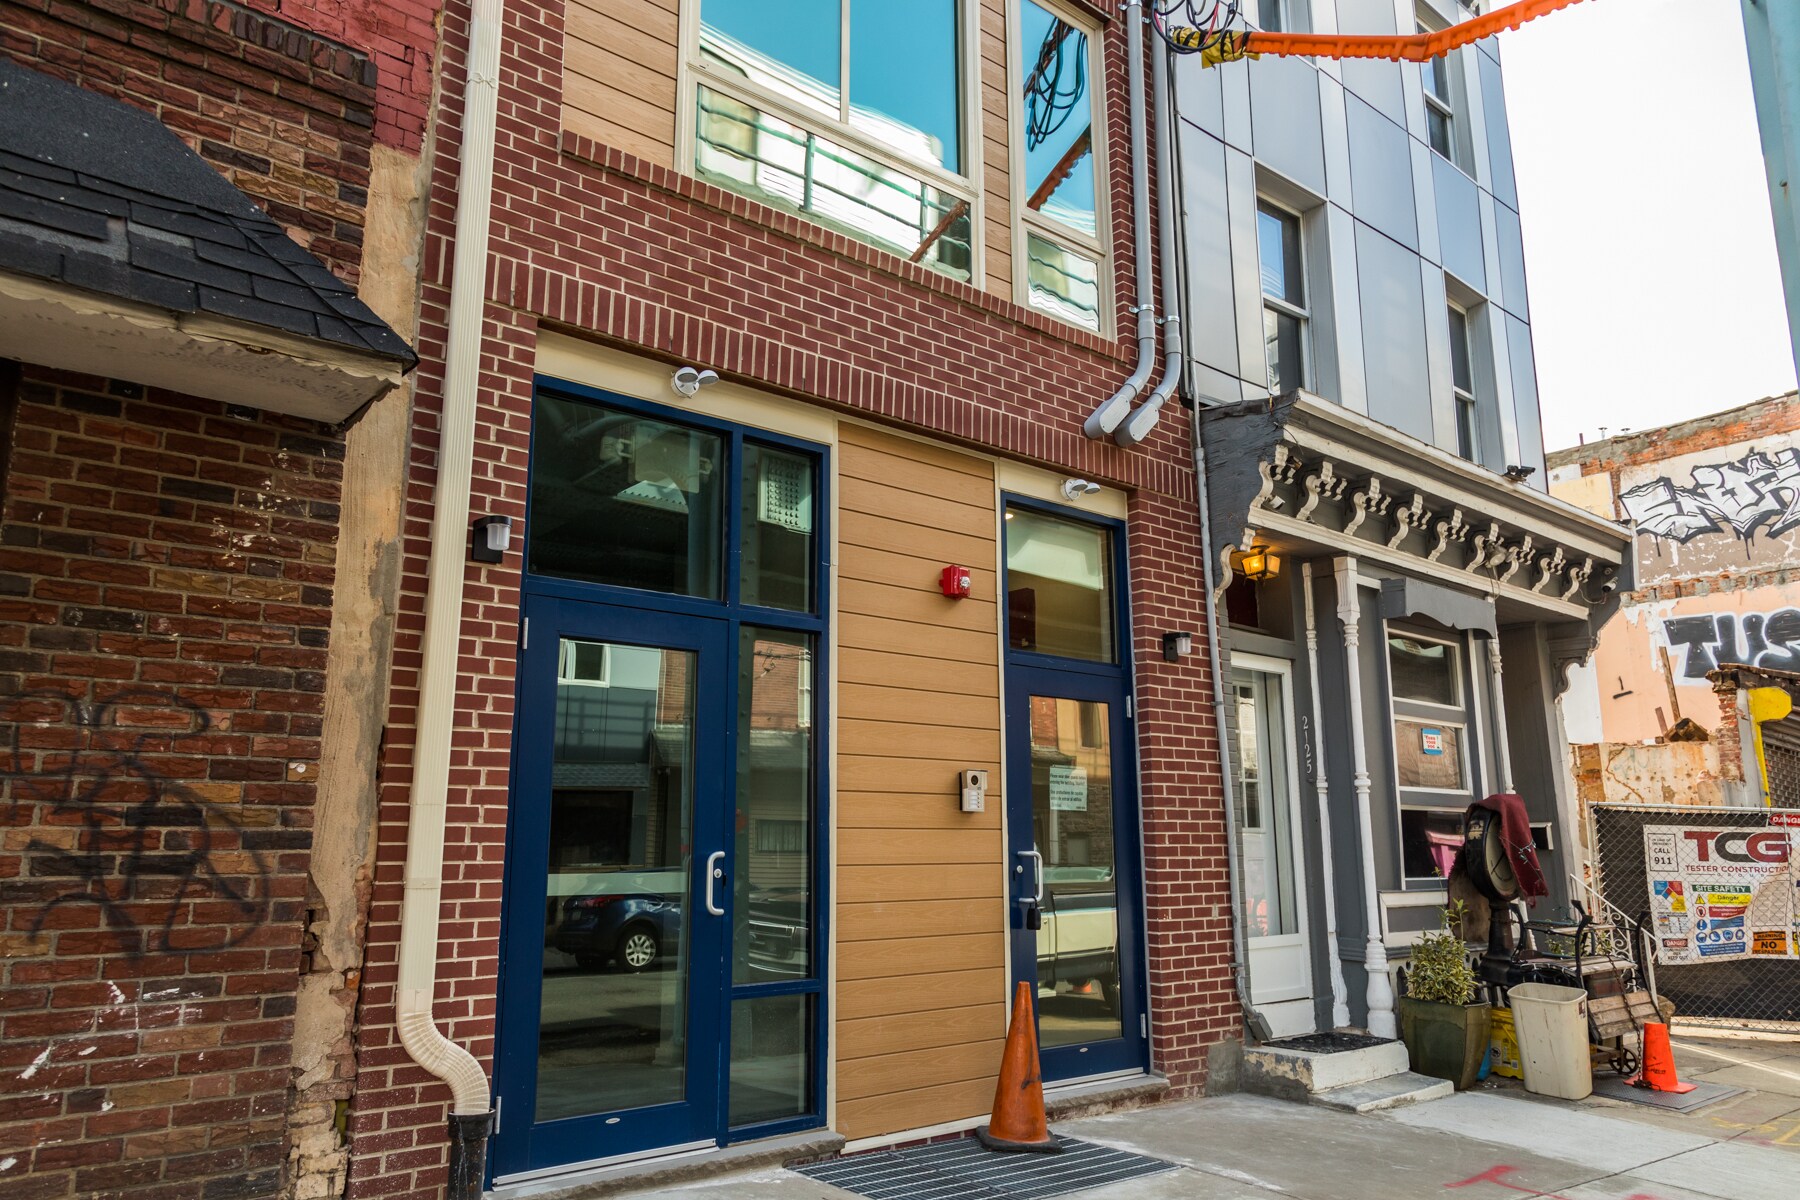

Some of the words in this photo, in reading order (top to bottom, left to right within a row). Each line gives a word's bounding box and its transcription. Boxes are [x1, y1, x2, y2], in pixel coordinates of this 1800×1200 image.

[1301, 716, 1312, 774] 2125
[1684, 831, 1792, 863] TCG
[1654, 856, 1672, 865] 911
[1685, 864, 1718, 872] TESTER
[1696, 884, 1713, 892] SITE
[1761, 941, 1777, 949] NO
